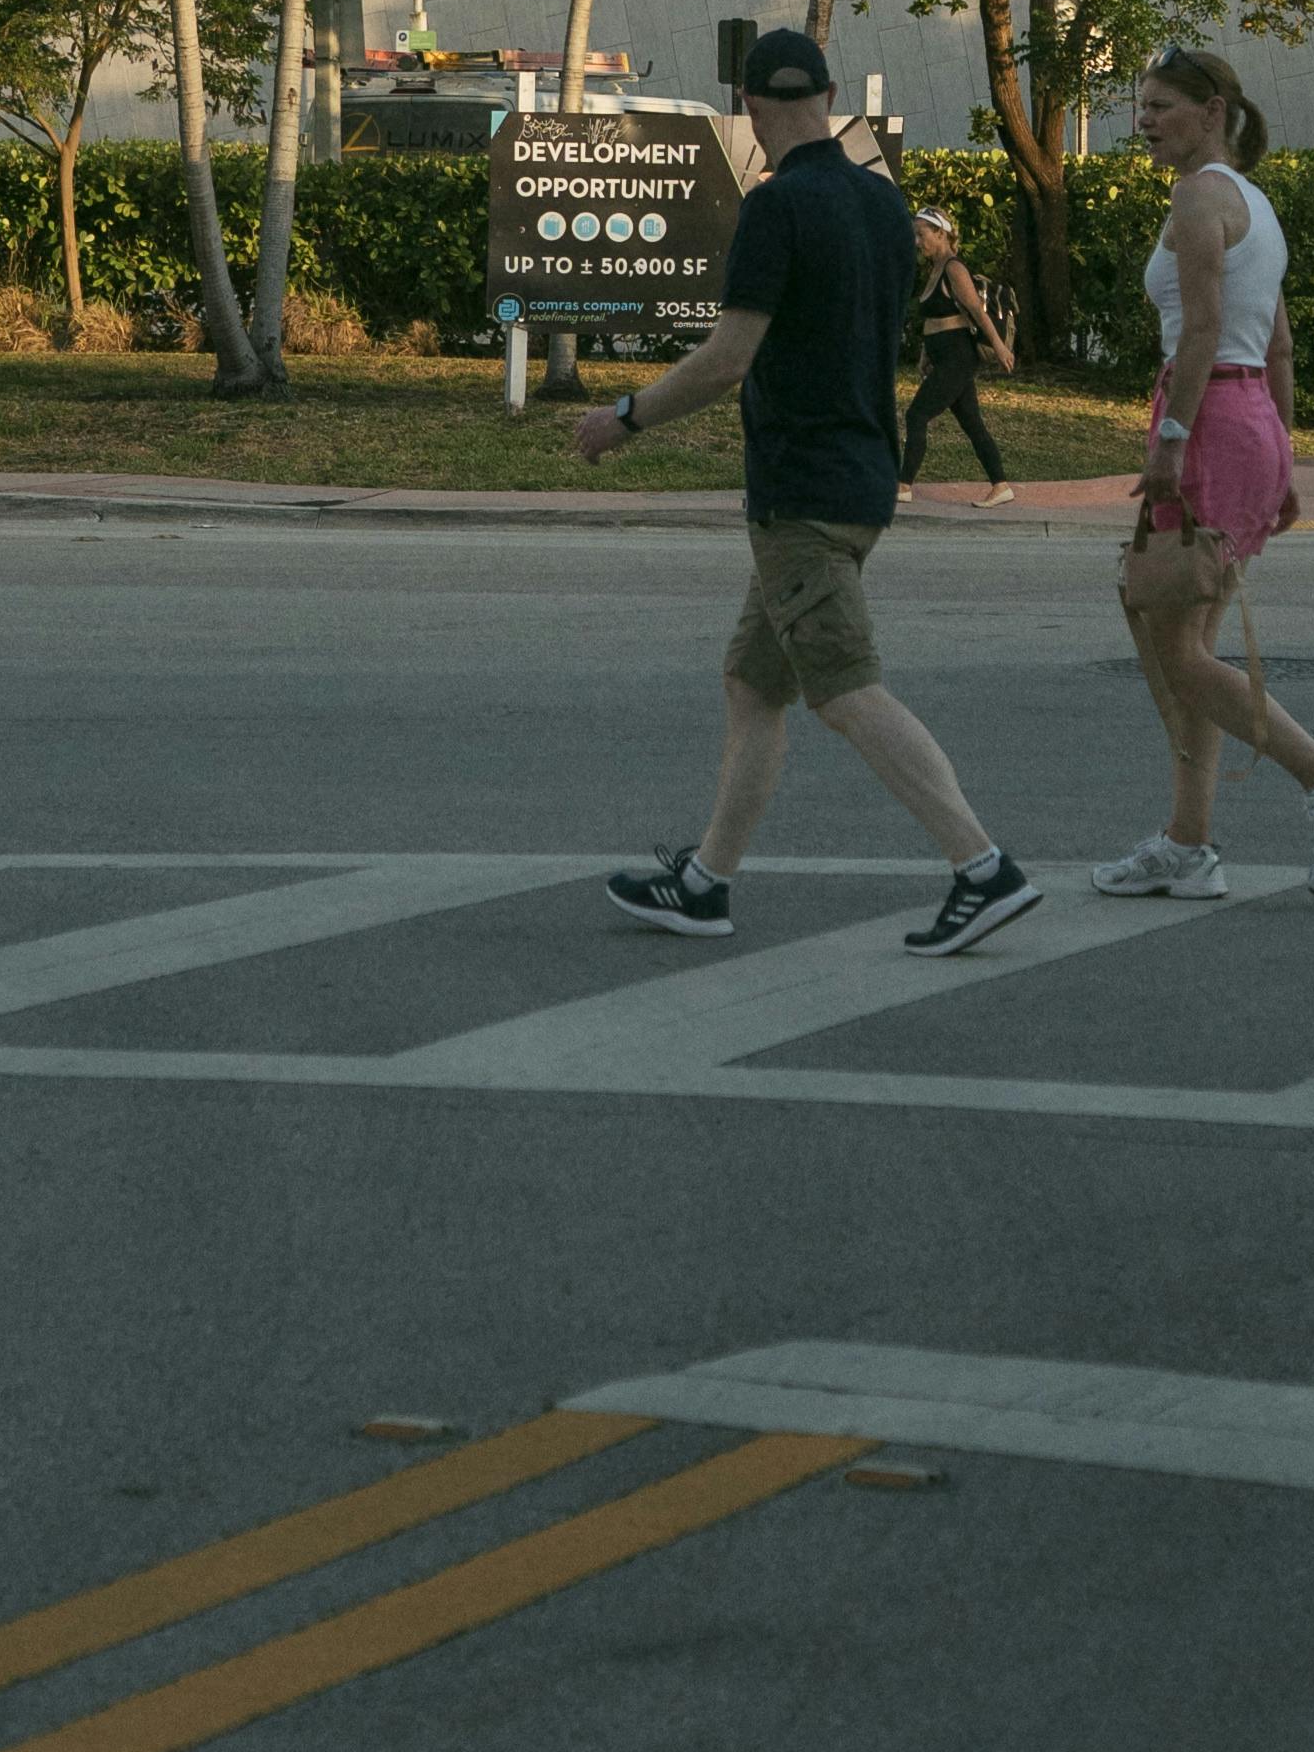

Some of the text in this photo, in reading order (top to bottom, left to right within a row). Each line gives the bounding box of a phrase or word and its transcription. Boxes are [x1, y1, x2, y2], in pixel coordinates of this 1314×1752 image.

[387, 129, 486, 148] LUMIX
[514, 140, 701, 165] DEVELOPMENT
[516, 176, 696, 200] OPPORTUNITY
[504, 256, 534, 274] UP
[542, 256, 573, 274] TO
[600, 257, 676, 278] 50,000
[682, 258, 708, 276] SF
[529, 300, 645, 314] comras company
[528, 311, 578, 324] redefining
